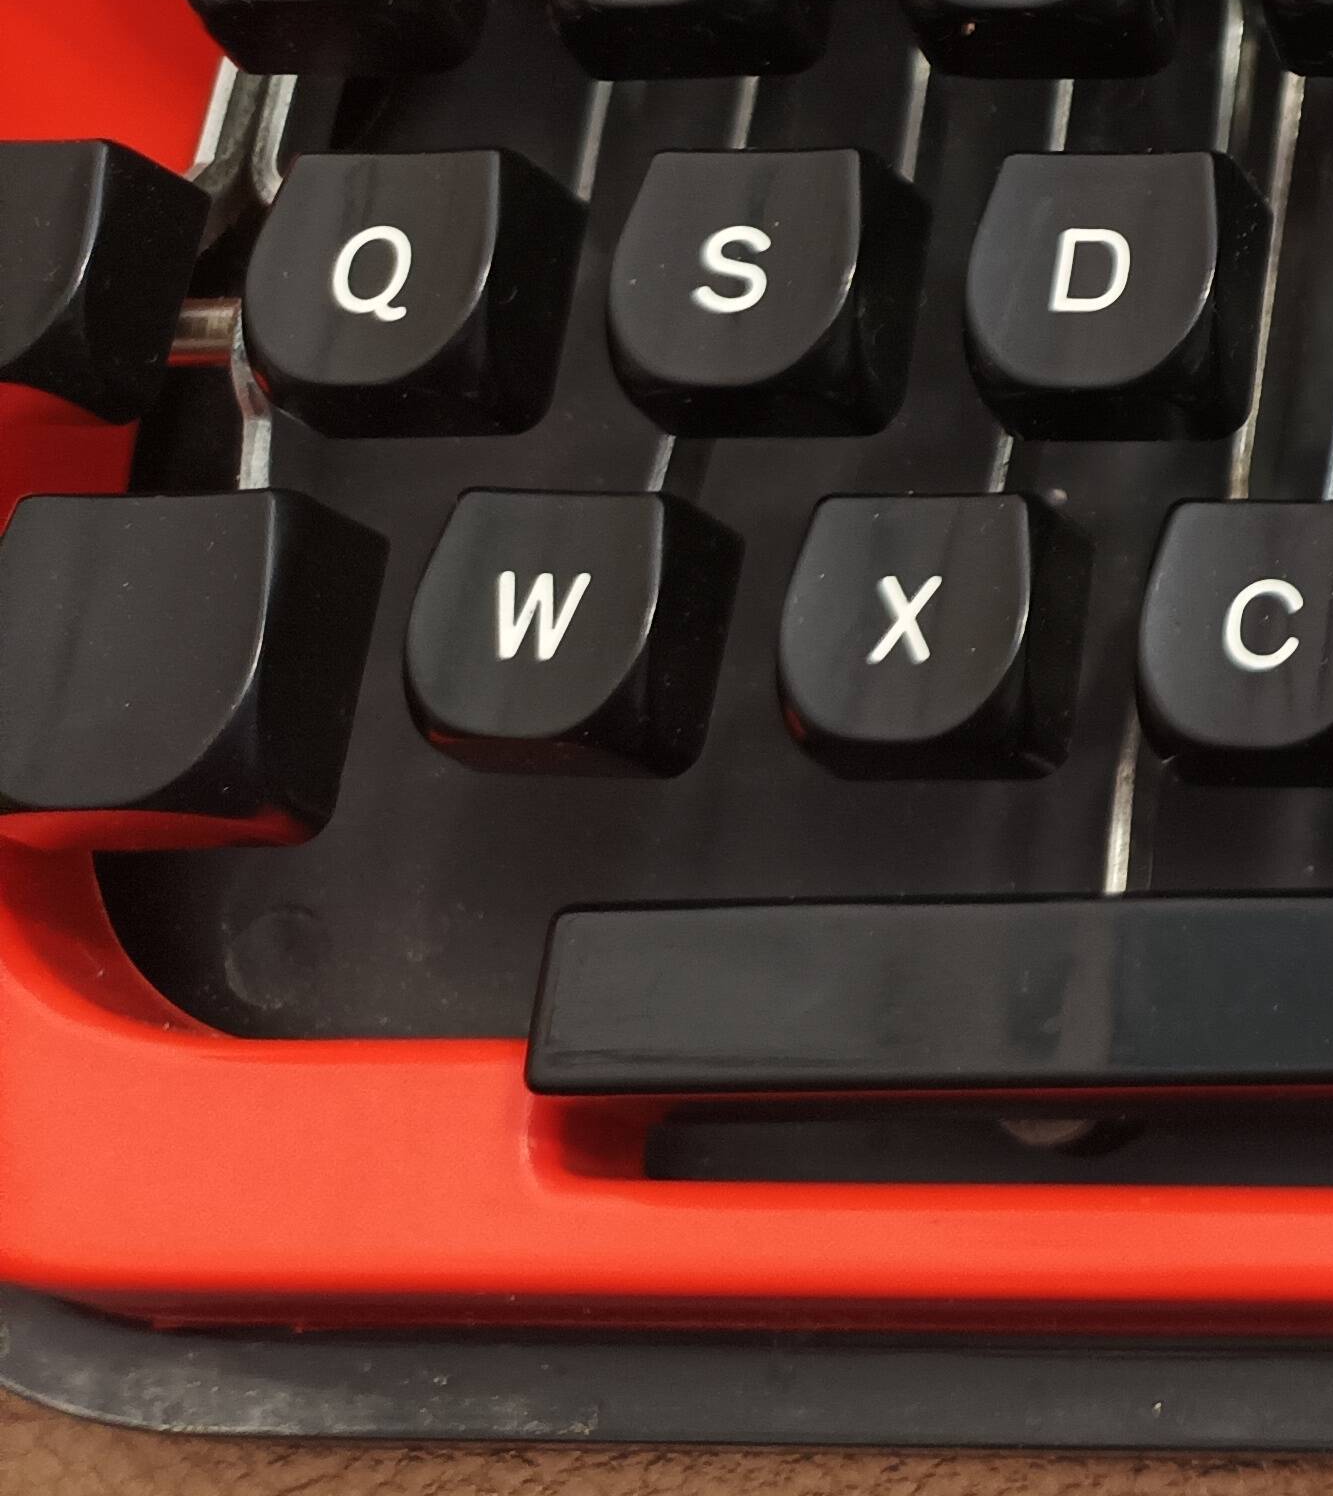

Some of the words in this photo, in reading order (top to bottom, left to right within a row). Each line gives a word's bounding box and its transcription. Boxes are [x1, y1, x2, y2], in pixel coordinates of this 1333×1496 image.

[331, 224, 413, 323] Q
[692, 224, 773, 314] S
[1049, 227, 1132, 313] D
[496, 569, 593, 662] W
[867, 574, 944, 664] X
[1223, 577, 1305, 671] C
